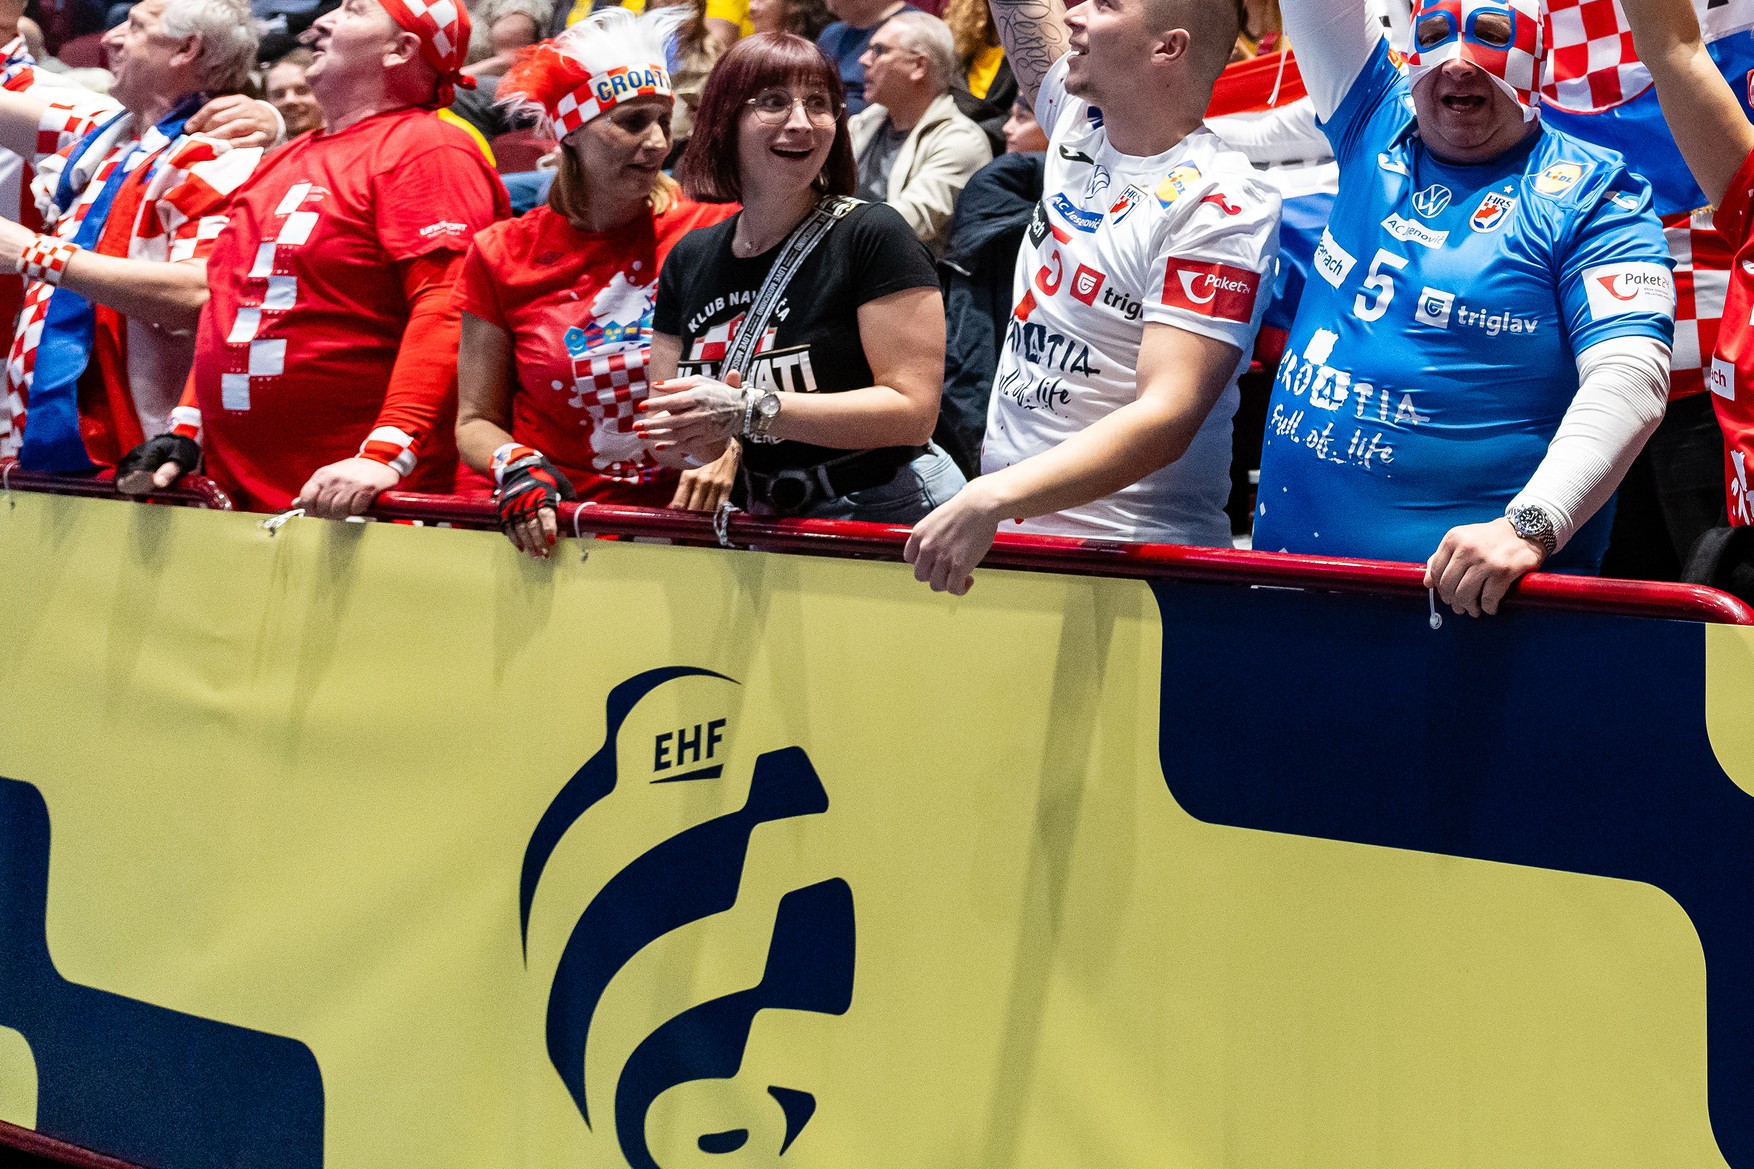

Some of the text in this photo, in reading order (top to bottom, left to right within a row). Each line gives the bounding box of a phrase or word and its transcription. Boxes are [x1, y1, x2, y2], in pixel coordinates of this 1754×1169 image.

[1123, 188, 1142, 203] HRS
[1486, 194, 1514, 208] HRS
[1387, 219, 1405, 234] AC
[756, 267, 788, 316] LOVE MOSCHINO
[1353, 247, 1409, 322] 5
[688, 296, 726, 334] KLUB
[729, 290, 791, 322] NAČA
[1102, 286, 1144, 321] trig
[1457, 305, 1539, 336] triglav
[731, 333, 752, 372] LOVE MOSC
[1036, 376, 1072, 411] life
[1347, 429, 1395, 469] life
[653, 718, 727, 772] EHF
